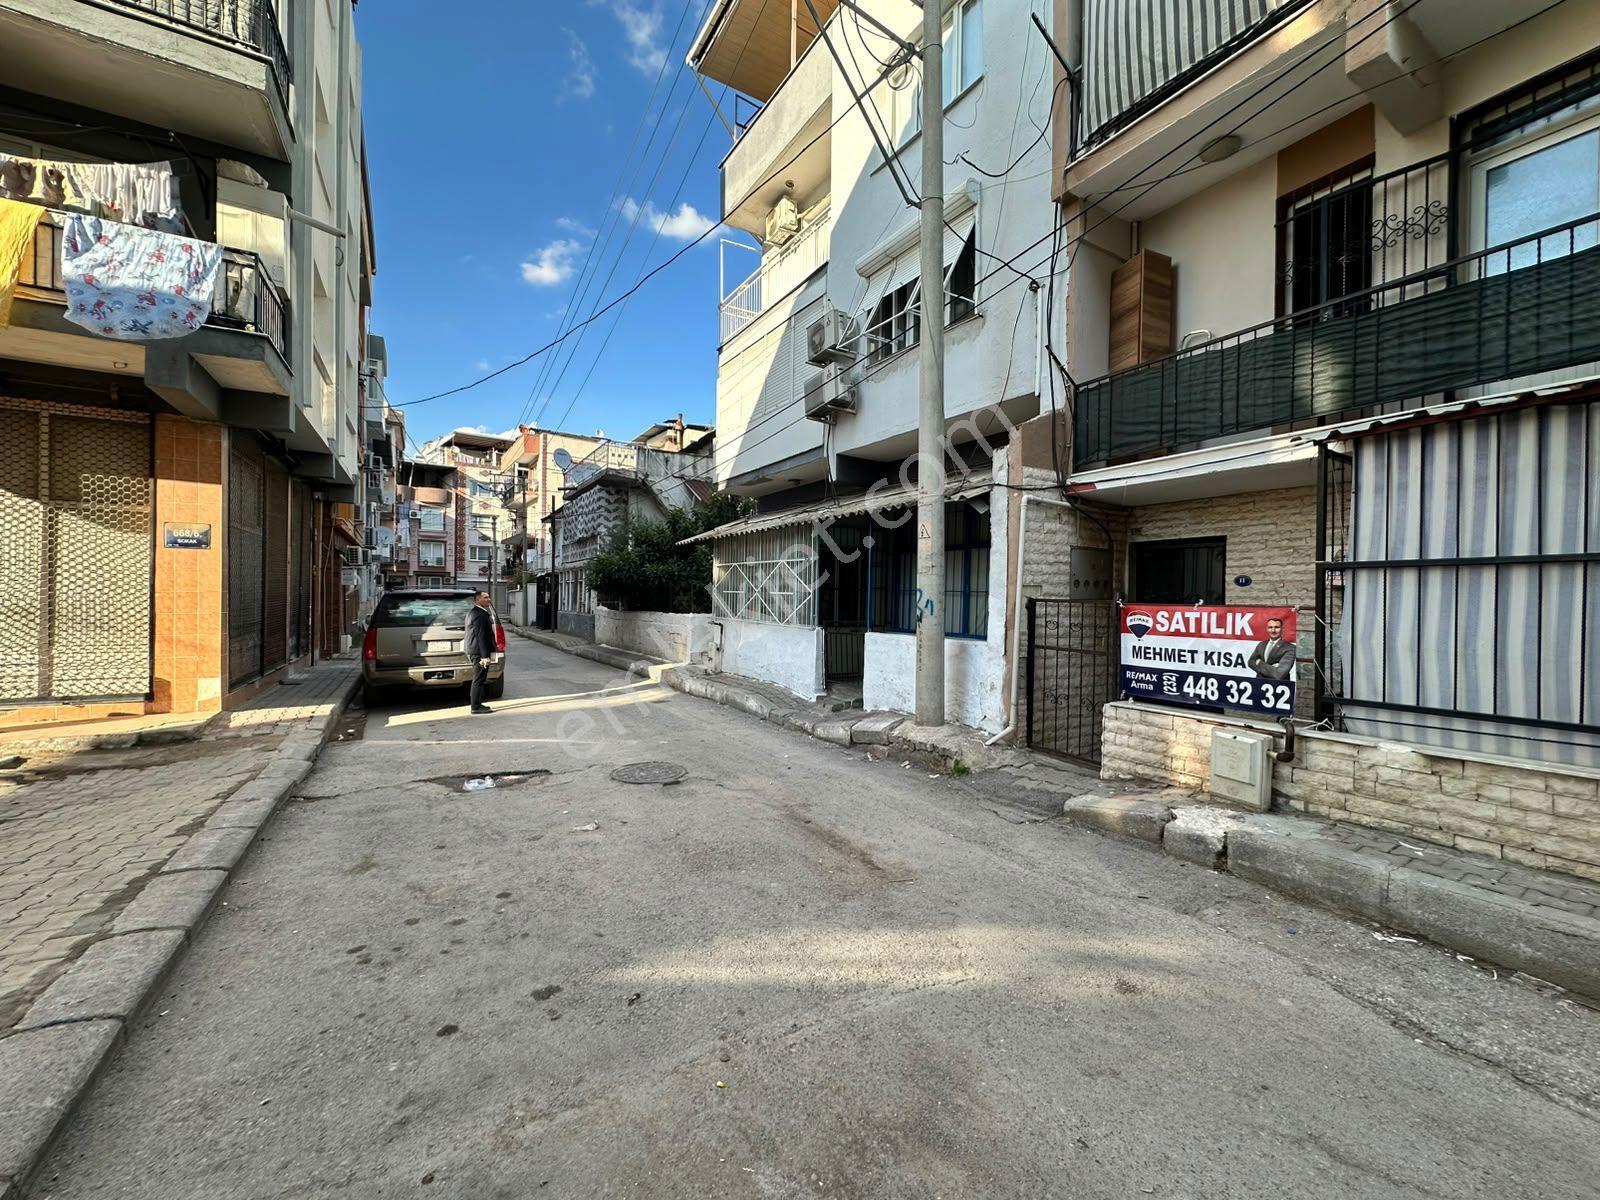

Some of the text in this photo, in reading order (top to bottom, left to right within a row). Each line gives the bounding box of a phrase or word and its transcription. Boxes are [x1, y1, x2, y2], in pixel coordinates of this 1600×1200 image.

[1156, 611, 1254, 636] SATILIK
[1132, 645, 1247, 668] MEHMET KISA
[1126, 671, 1157, 682] RE/MAX
[1131, 681, 1154, 691] Arma
[1163, 673, 1180, 695] (232)
[1183, 675, 1290, 710] 448 32 32
